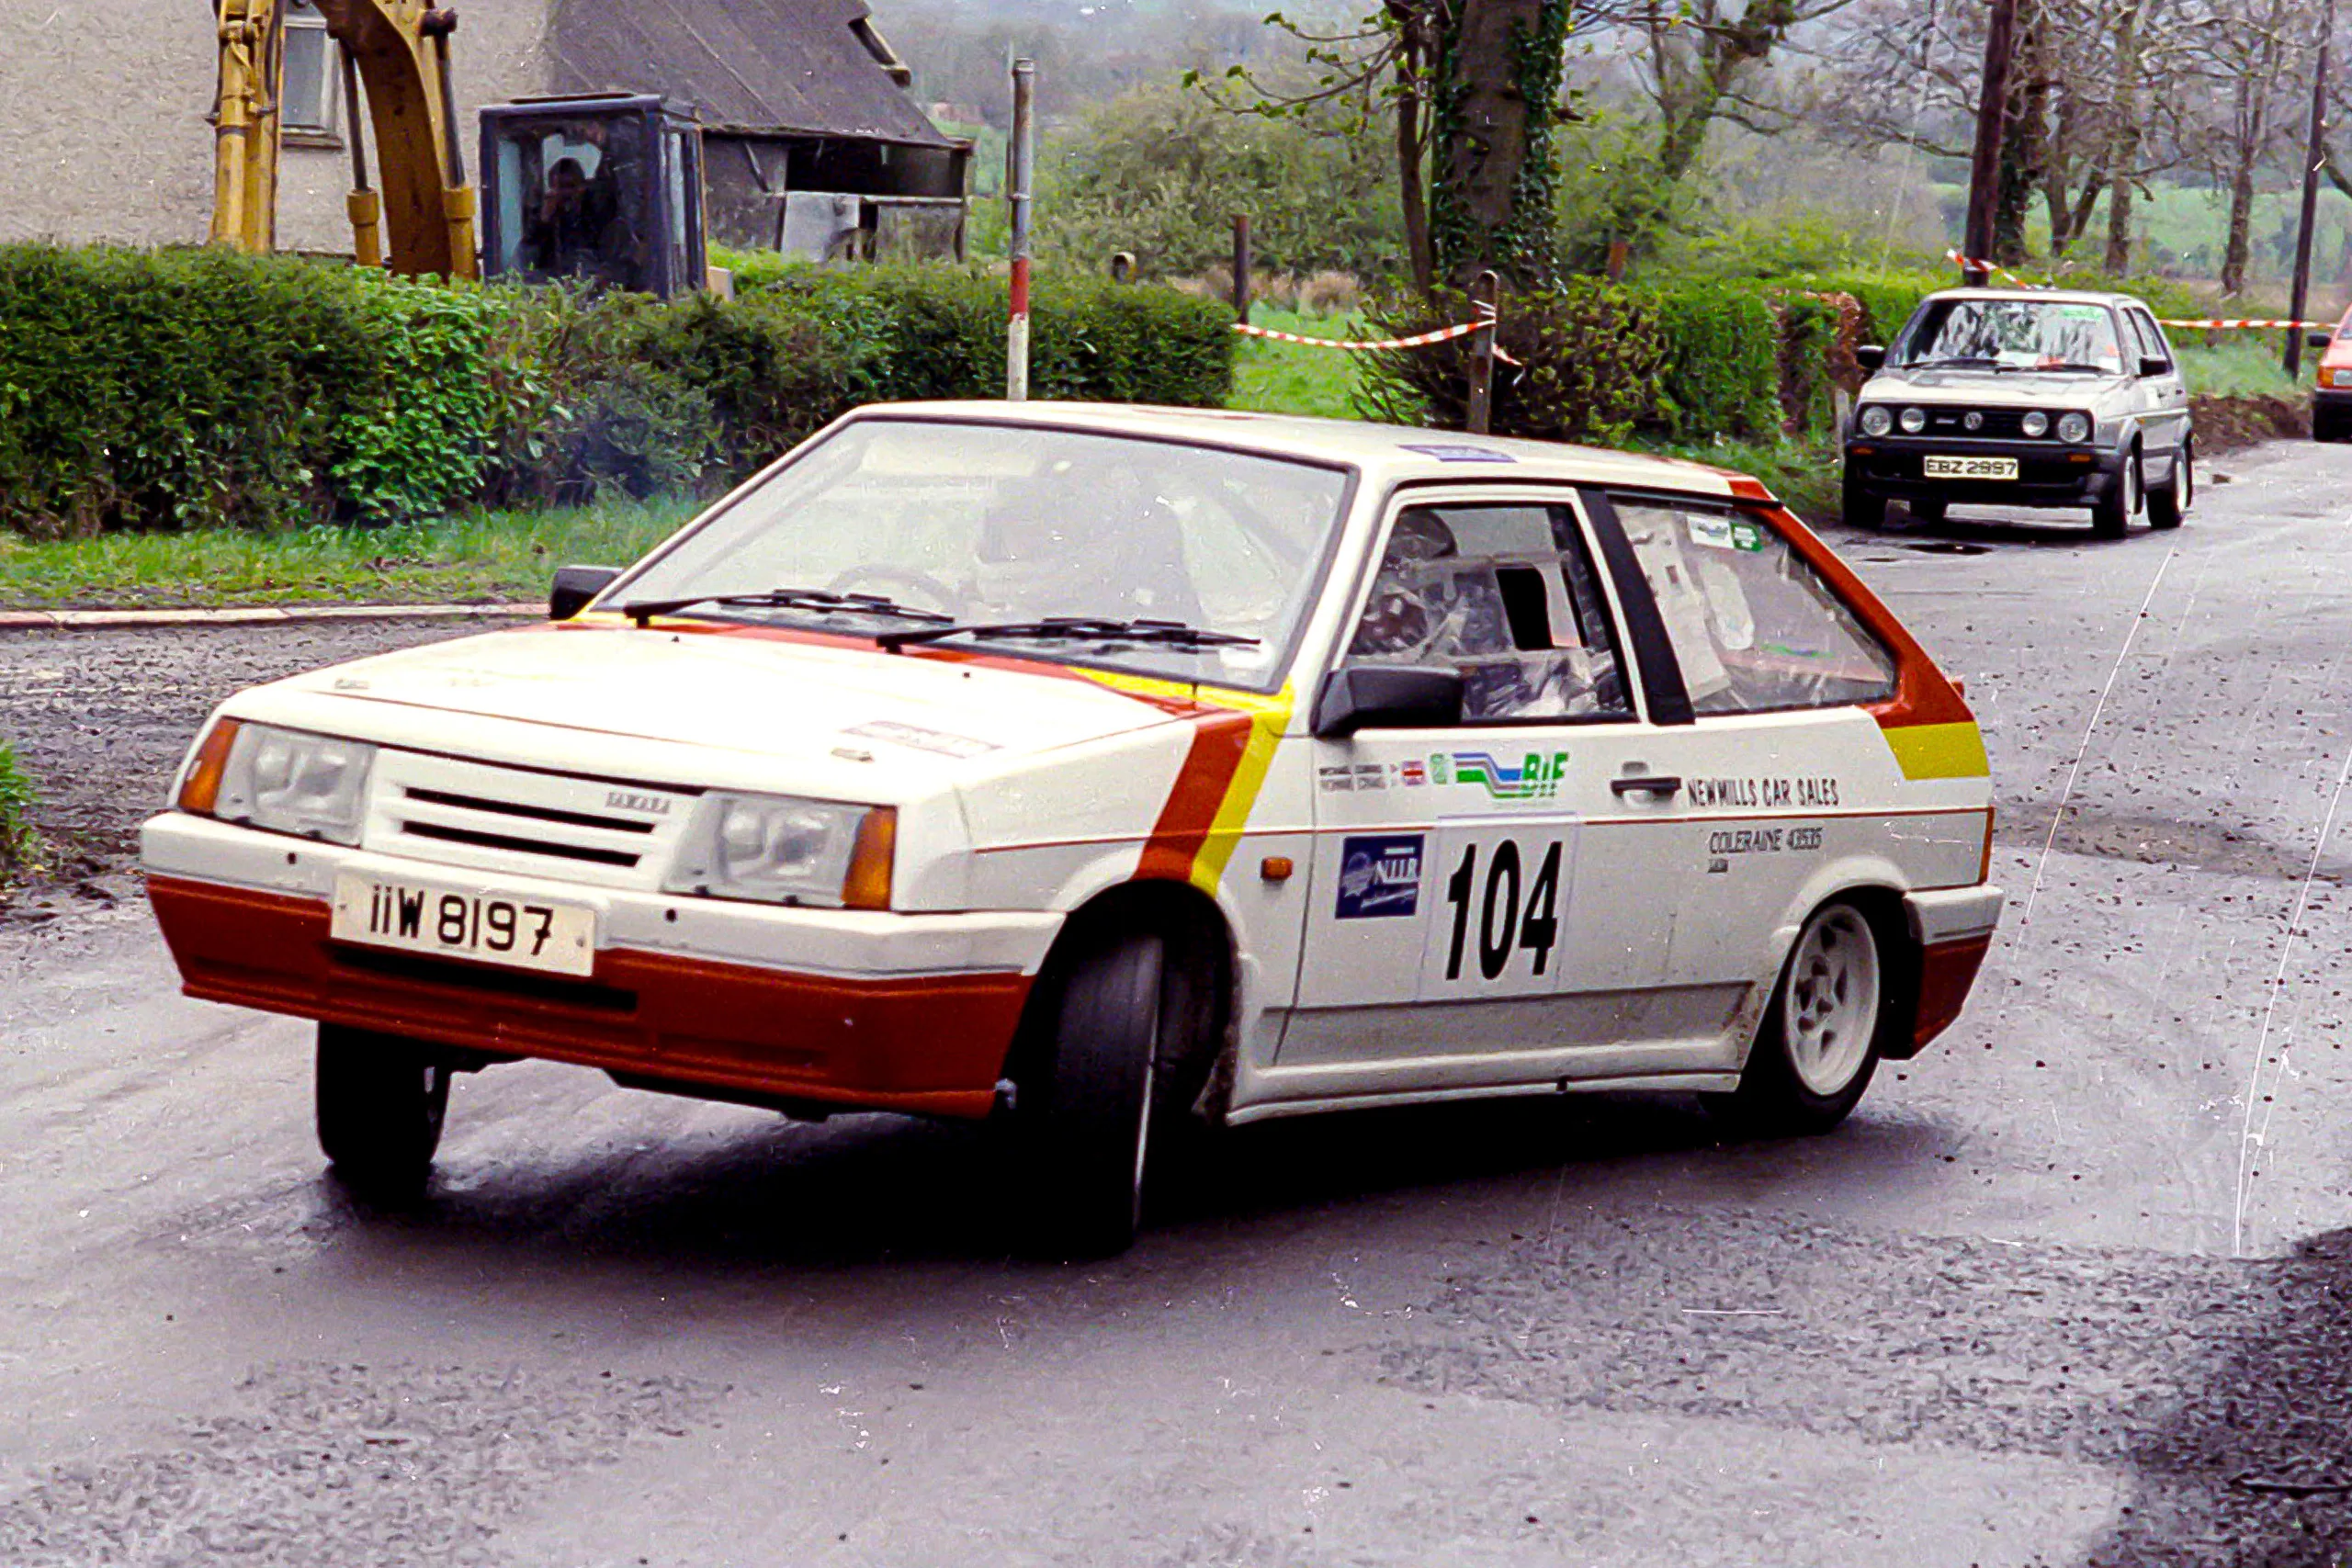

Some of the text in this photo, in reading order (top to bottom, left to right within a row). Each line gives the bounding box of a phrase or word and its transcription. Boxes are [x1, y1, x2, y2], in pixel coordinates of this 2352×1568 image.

[1927, 458, 1963, 474] EBZ
[1762, 778, 1792, 807] CAR
[1797, 777, 1839, 807] SALES
[437, 894, 554, 956] 8197
[1445, 839, 1563, 980] 104
